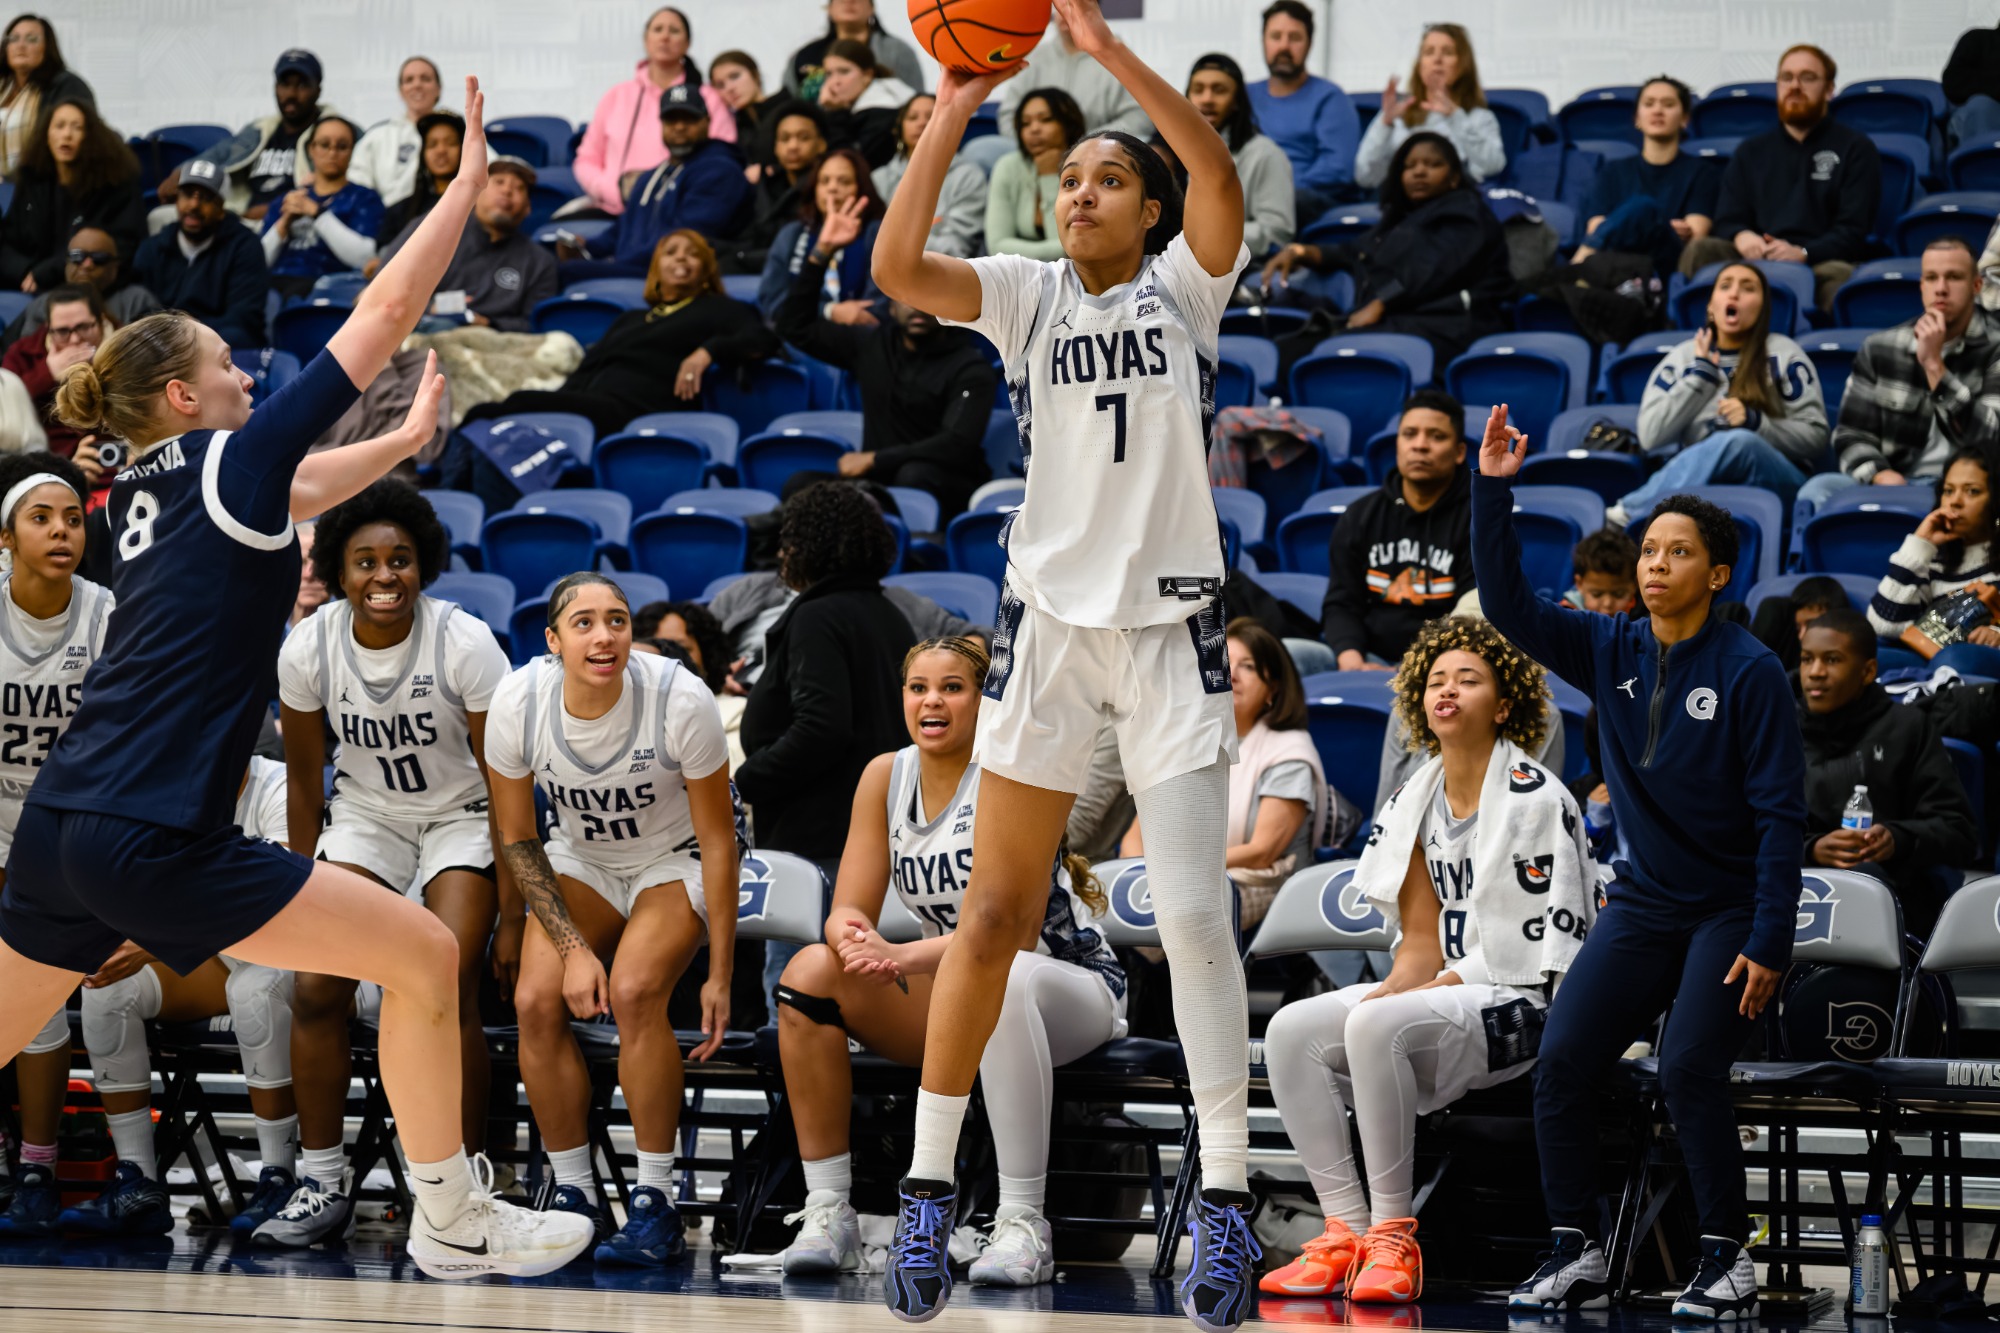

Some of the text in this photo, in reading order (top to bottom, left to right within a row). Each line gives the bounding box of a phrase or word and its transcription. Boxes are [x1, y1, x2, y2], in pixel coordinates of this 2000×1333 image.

[1134, 291, 1158, 302] CHANG
[1138, 301, 1155, 313] BIG
[1136, 305, 1161, 320] EAST
[1051, 327, 1168, 385] HOYAS
[1095, 392, 1127, 463] 7
[118, 489, 160, 562] 8
[1203, 581, 1213, 590] 46
[410, 690, 432, 699] EAST
[1685, 687, 1718, 720] G
[2, 723, 59, 767] 23
[341, 711, 438, 751] HOYAS
[631, 753, 655, 761] CHANGE
[643, 747, 655, 755] THE
[376, 753, 428, 793] 10
[628, 765, 651, 774] EAST
[548, 780, 656, 812] HOYAS
[894, 847, 973, 896] HOYAS
[1946, 1062, 2000, 1087] HOYAS
